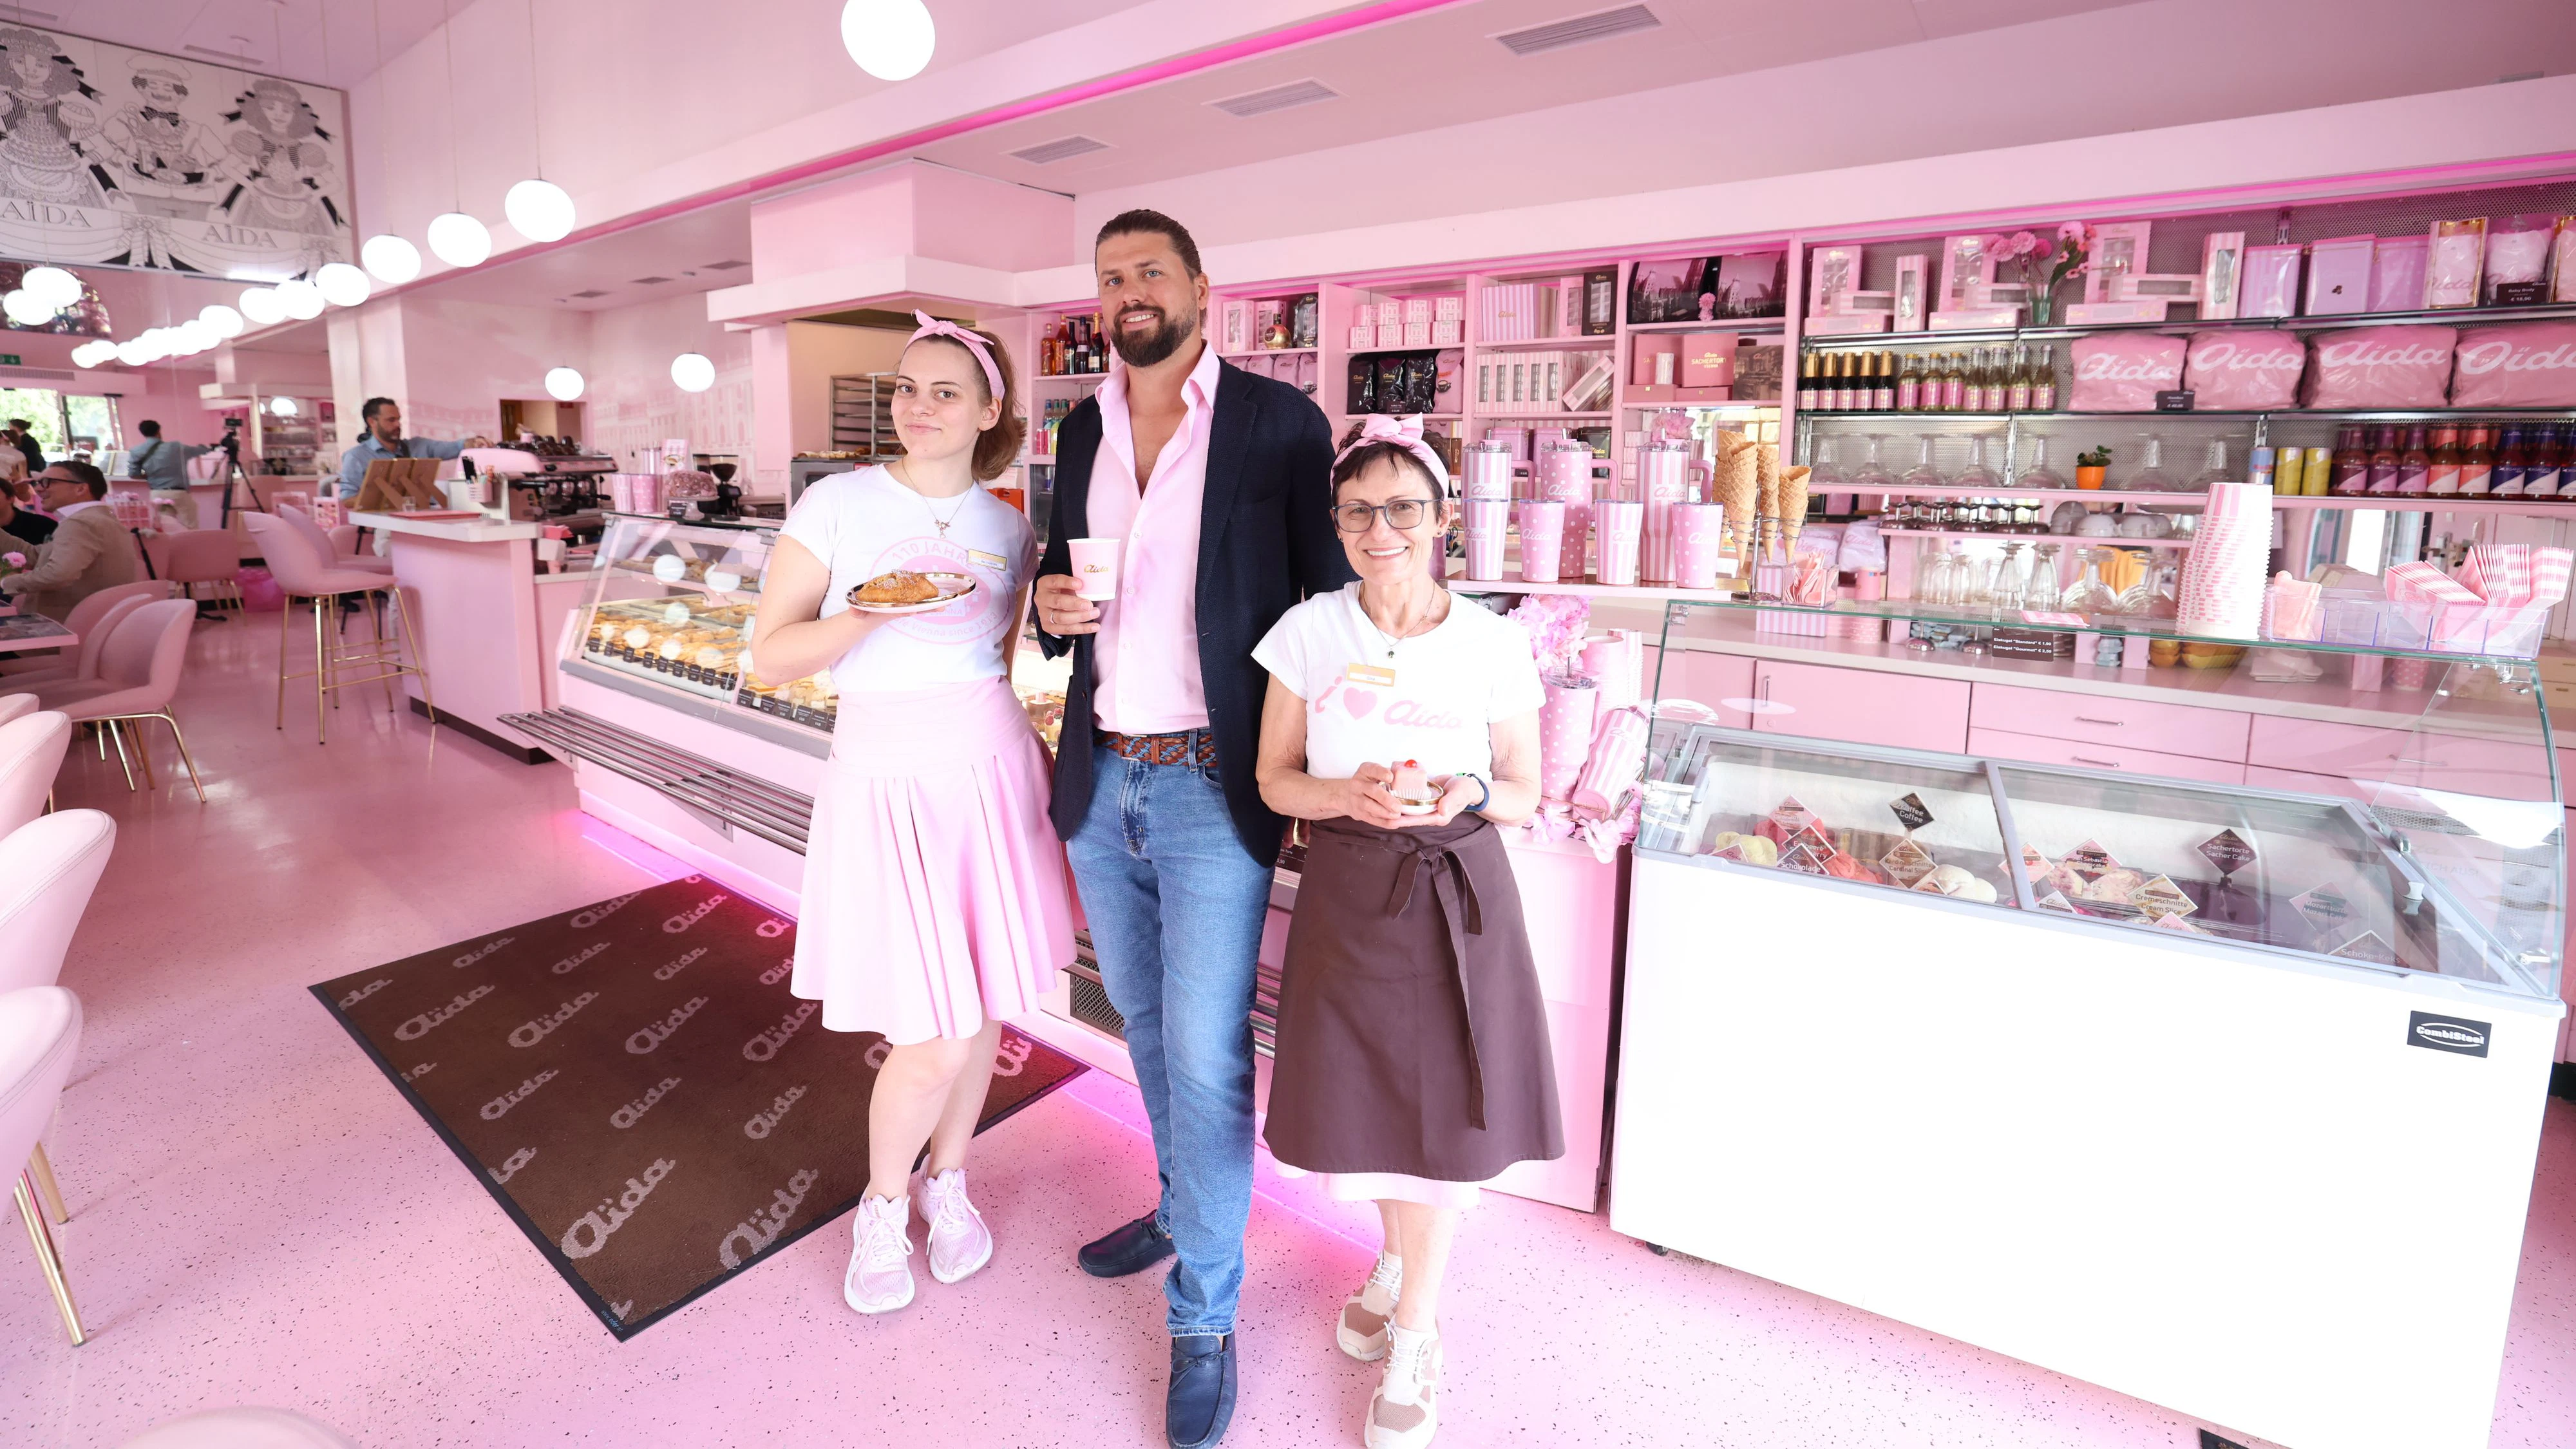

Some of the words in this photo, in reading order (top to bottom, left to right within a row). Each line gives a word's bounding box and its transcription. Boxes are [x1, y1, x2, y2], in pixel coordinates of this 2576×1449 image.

[1900, 810, 1924, 824] Coffee
[2206, 850, 2231, 858] Sacher
[2207, 843, 2249, 854] Sachertorte
[1781, 861, 1821, 874] Schokolade
[2136, 894, 2188, 907] Cremeschnitte
[2141, 903, 2164, 913] Cream
[2340, 948, 2401, 963] Schoko-Keks
[2416, 1026, 2485, 1045] CombiSteel
